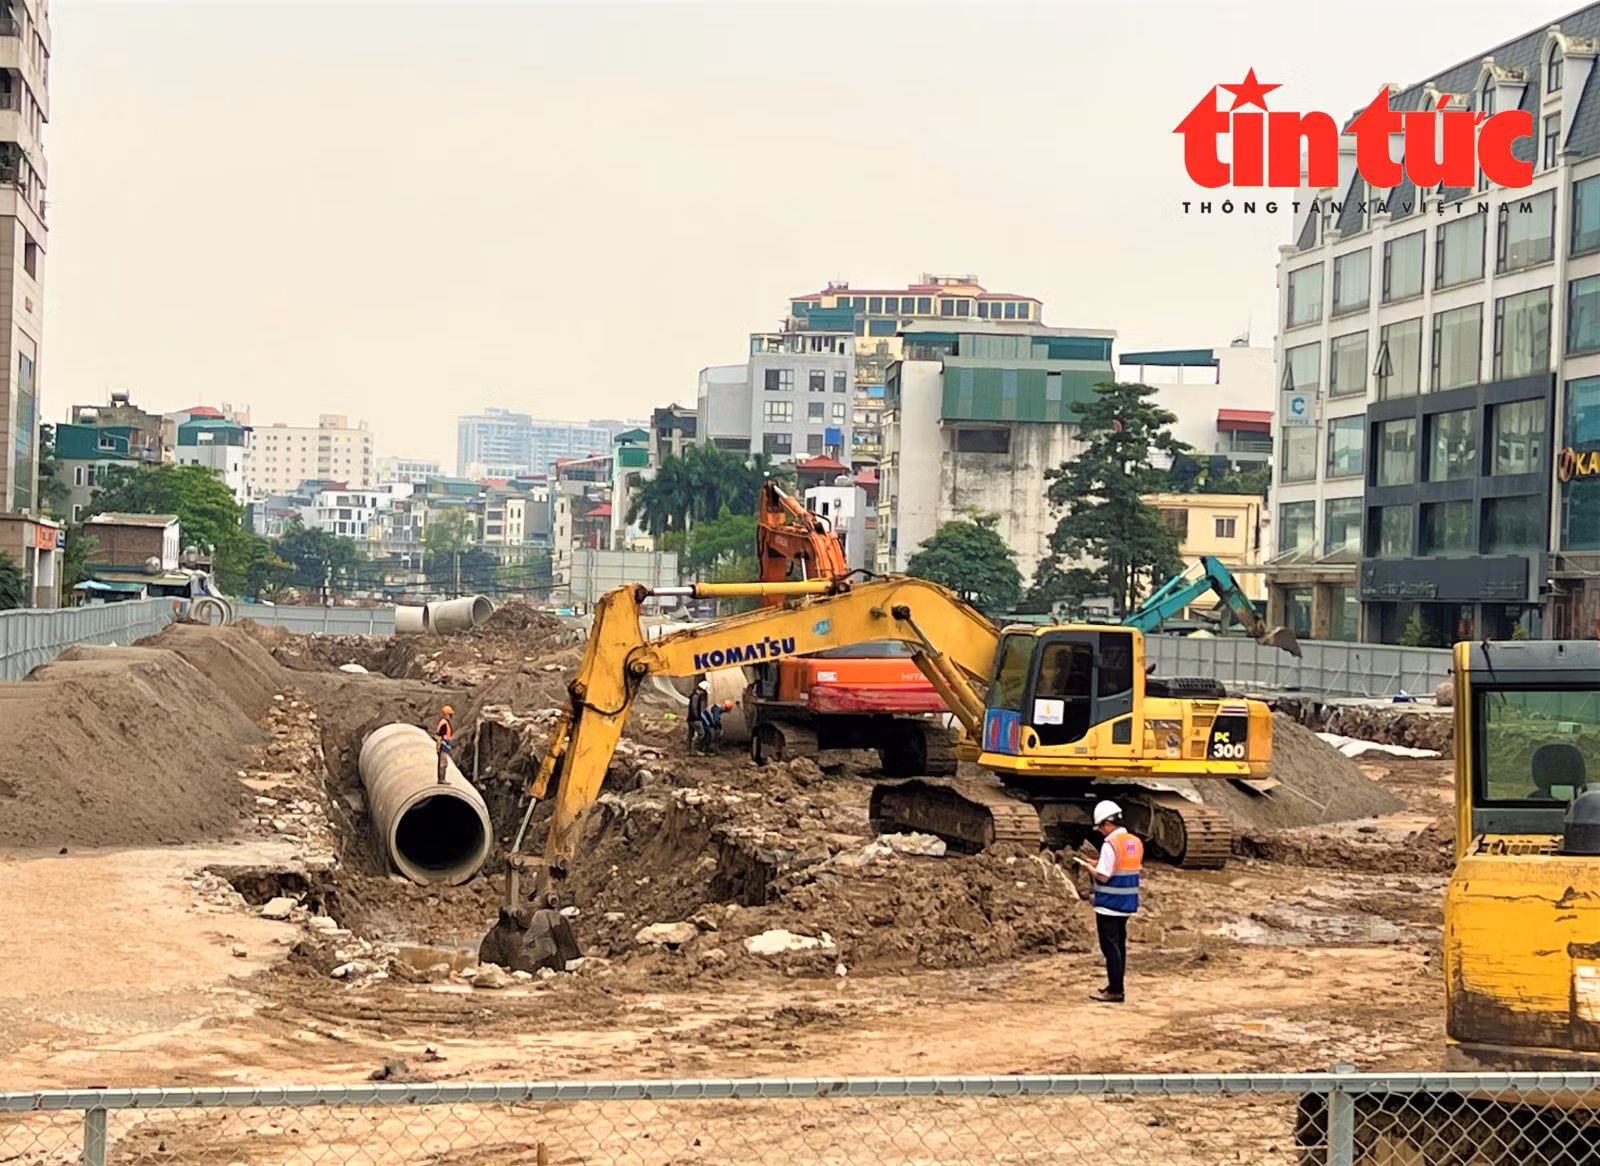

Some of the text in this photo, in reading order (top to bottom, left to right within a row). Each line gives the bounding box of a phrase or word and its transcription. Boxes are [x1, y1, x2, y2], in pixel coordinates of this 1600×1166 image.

[694, 637, 795, 669] KOMATSU
[1214, 731, 1231, 743] PC
[1213, 743, 1245, 758] 300
